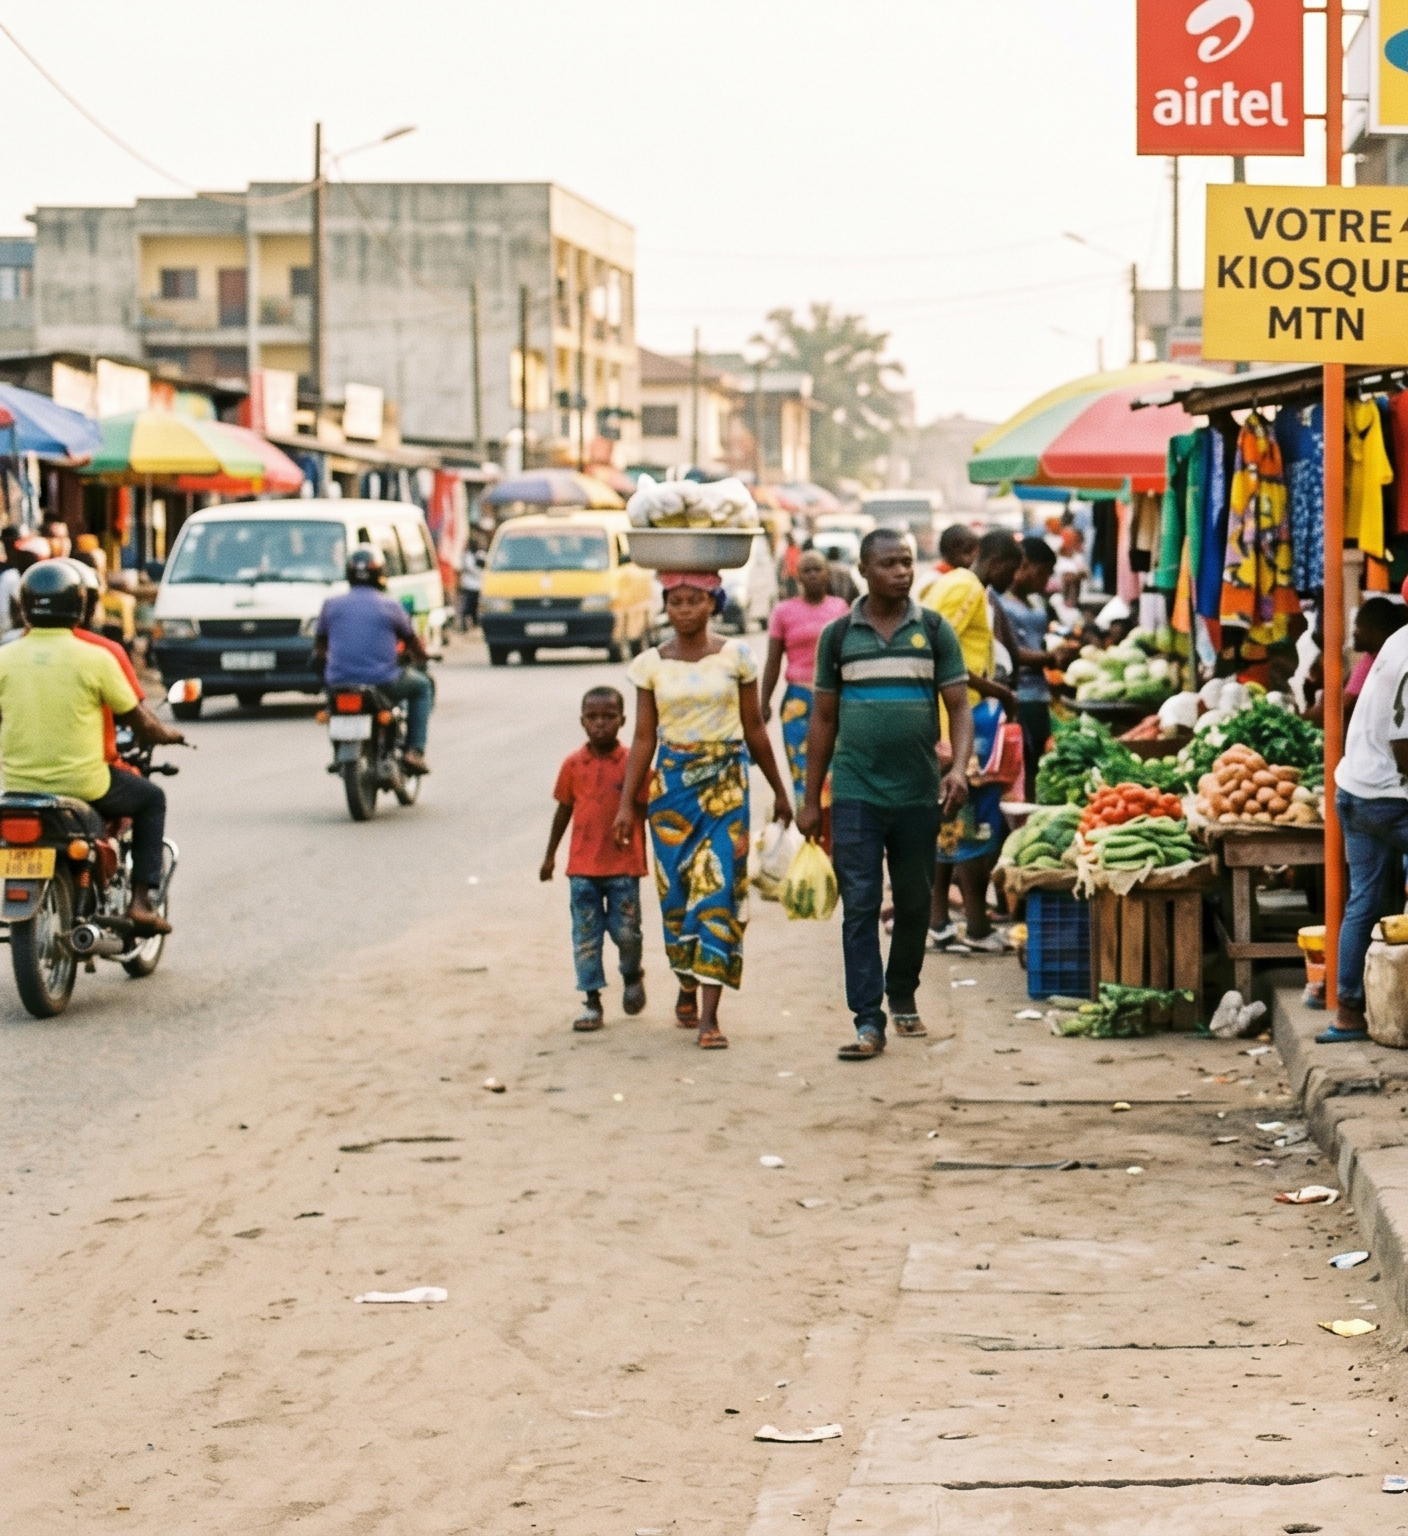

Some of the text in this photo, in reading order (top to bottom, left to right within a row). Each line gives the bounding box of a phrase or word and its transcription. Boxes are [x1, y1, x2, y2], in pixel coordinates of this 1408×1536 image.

[1154, 77, 1287, 125] airtel
[1245, 207, 1392, 243] VOTRE
[1269, 306, 1364, 341] MTN
